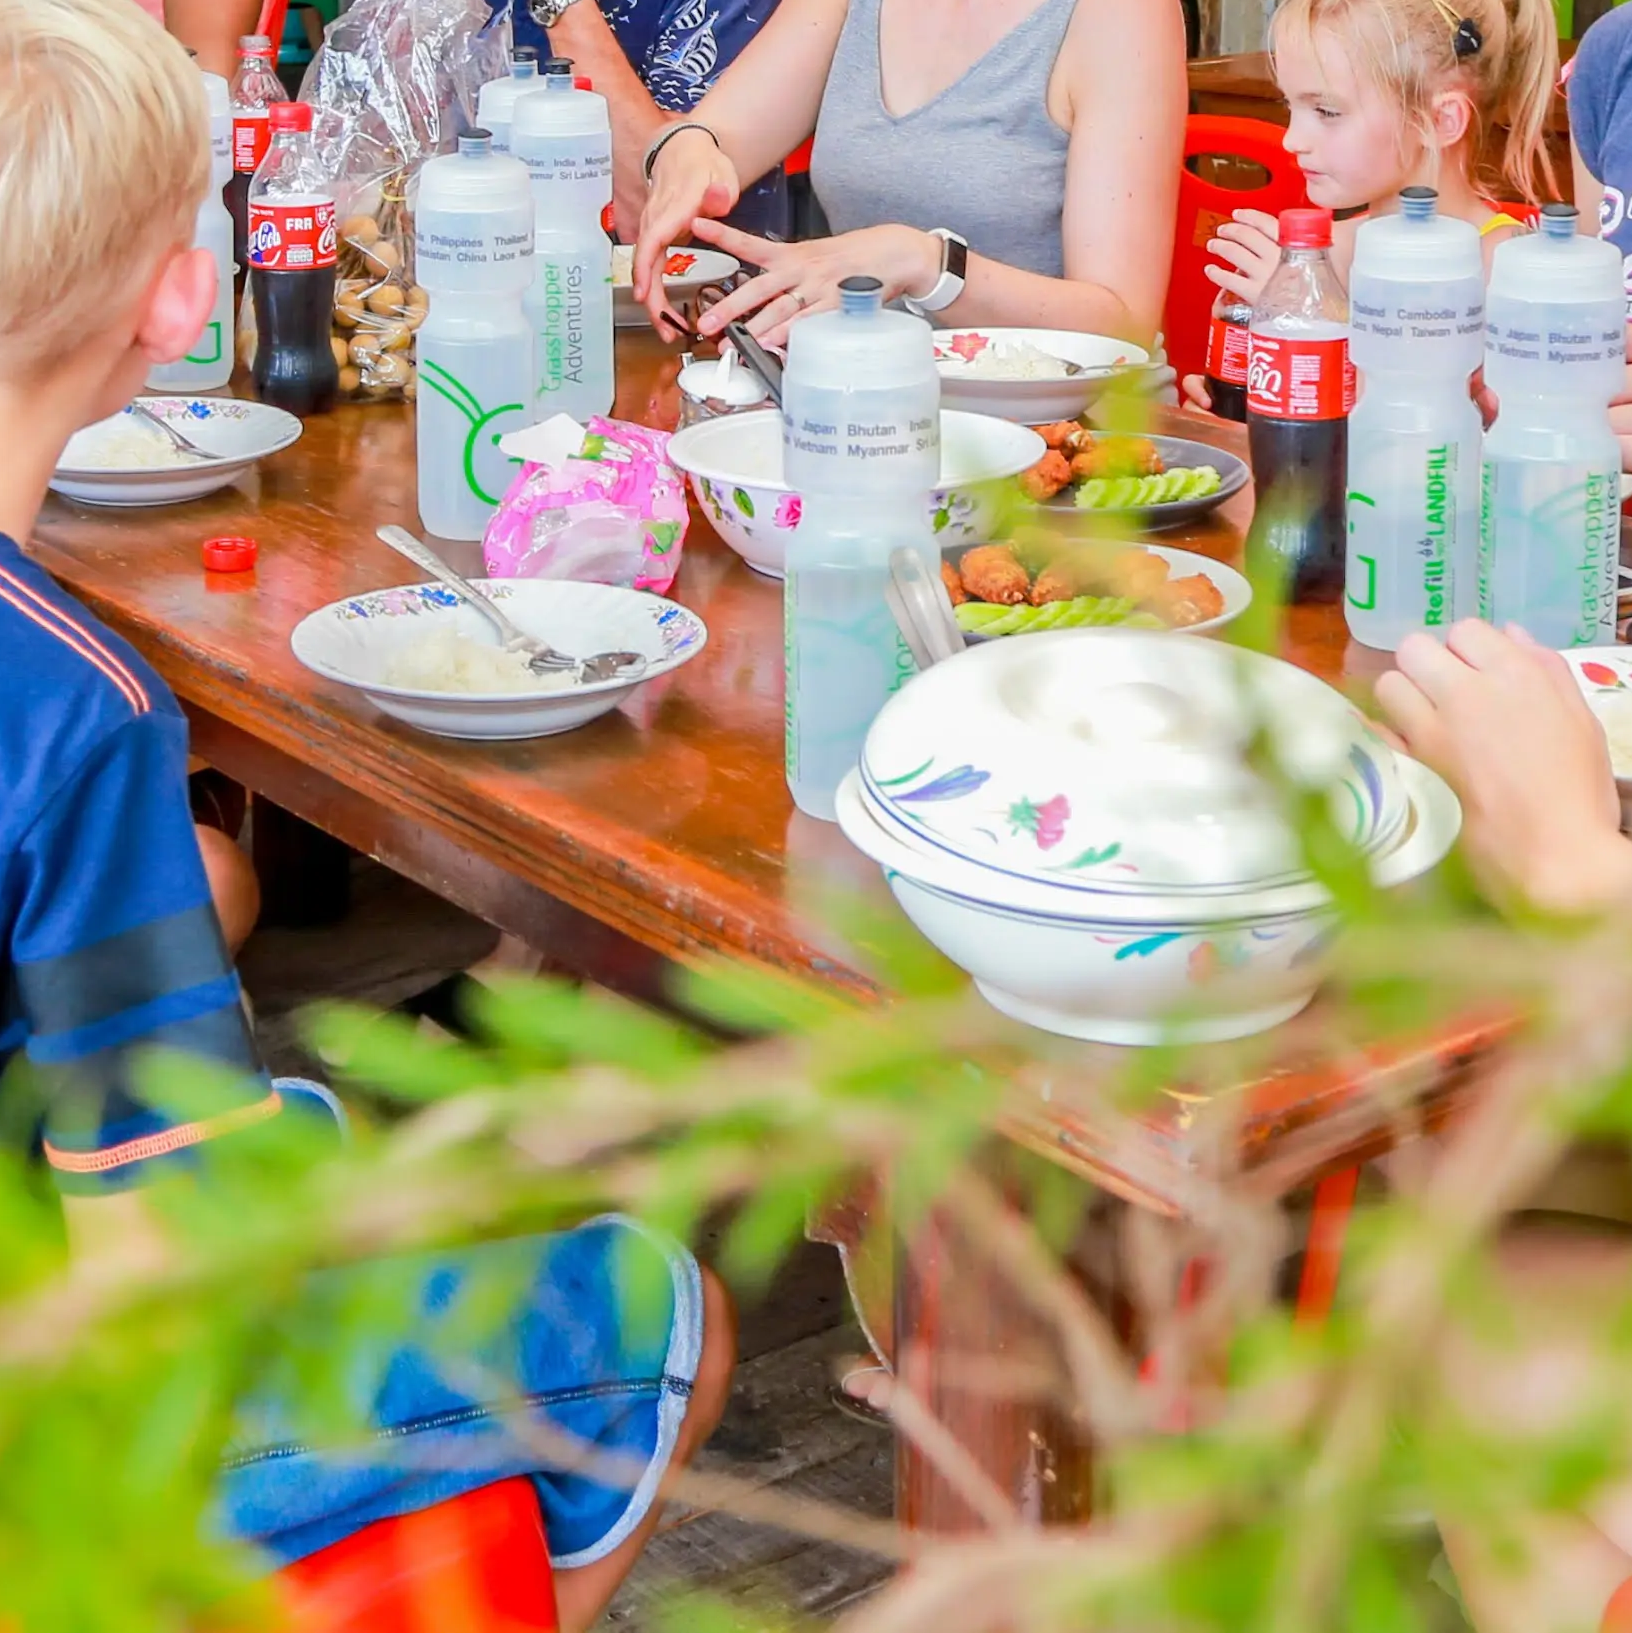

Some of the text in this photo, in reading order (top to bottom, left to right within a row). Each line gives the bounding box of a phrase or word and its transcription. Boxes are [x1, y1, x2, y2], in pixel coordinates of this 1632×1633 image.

[553, 158, 576, 167] India
[285, 216, 313, 231] FRA
[430, 234, 484, 248] Philippines
[456, 252, 487, 263] China
[1397, 309, 1457, 321] Cambodia
[536, 262, 564, 402] Grasshopper
[564, 265, 583, 384] Adventures
[1371, 323, 1403, 338] Nepal
[1411, 326, 1451, 338] Taiwan
[1548, 332, 1592, 344] Bhutan
[1548, 350, 1602, 364] Myanmar
[802, 419, 837, 435] Japan
[847, 424, 897, 437] Bhutan
[793, 436, 838, 455] Vietnam
[847, 443, 910, 459] Myanmar
[1426, 443, 1448, 536] LANDFILL
[1599, 470, 1618, 627] Adventures
[1572, 470, 1605, 646] Grasshopper
[1424, 559, 1445, 626] Refill
